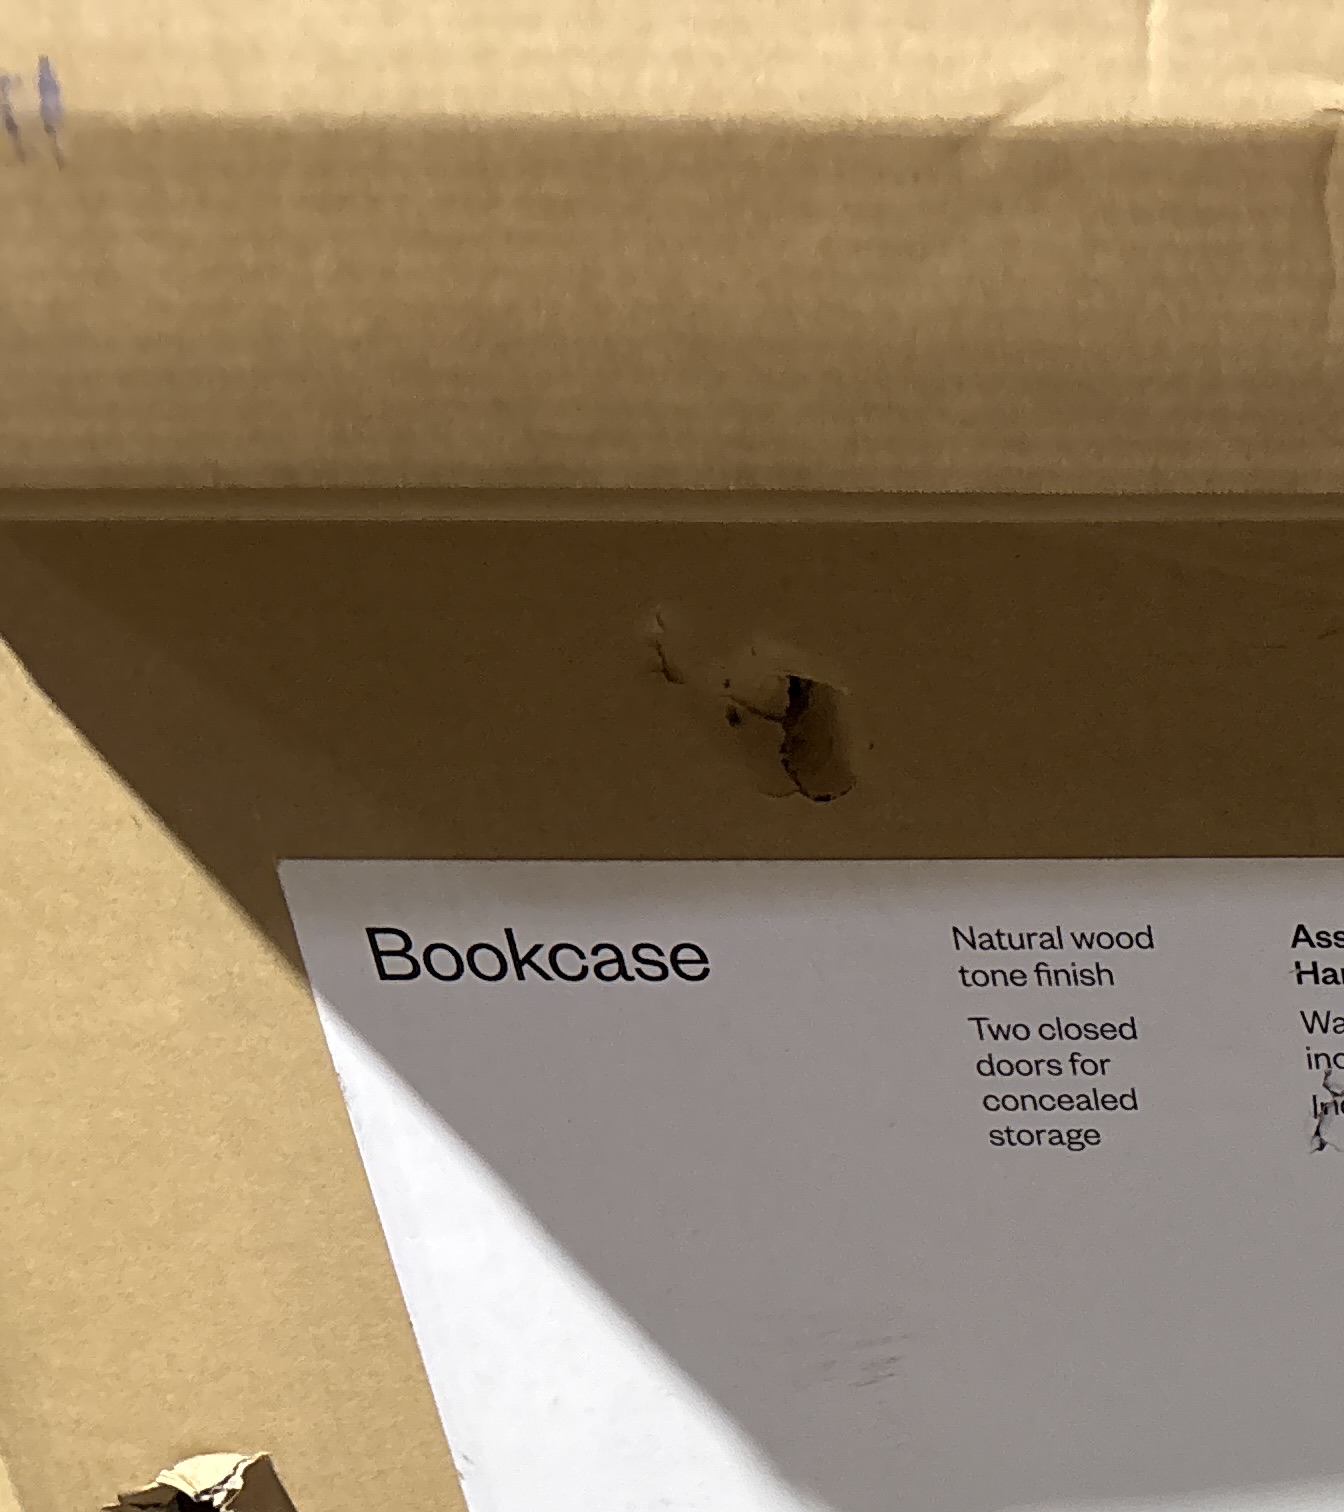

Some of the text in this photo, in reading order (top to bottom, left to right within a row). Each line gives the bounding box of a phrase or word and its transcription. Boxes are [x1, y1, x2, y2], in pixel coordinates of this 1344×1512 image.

[952, 925, 1154, 950] Natural wood
[365, 926, 710, 983] Bookcase
[958, 962, 1115, 987] tone finish
[967, 1016, 1138, 1041] Two closed
[976, 1052, 1111, 1077] doors for
[983, 1088, 1138, 1112] concealed
[989, 1125, 1101, 1151] storage
